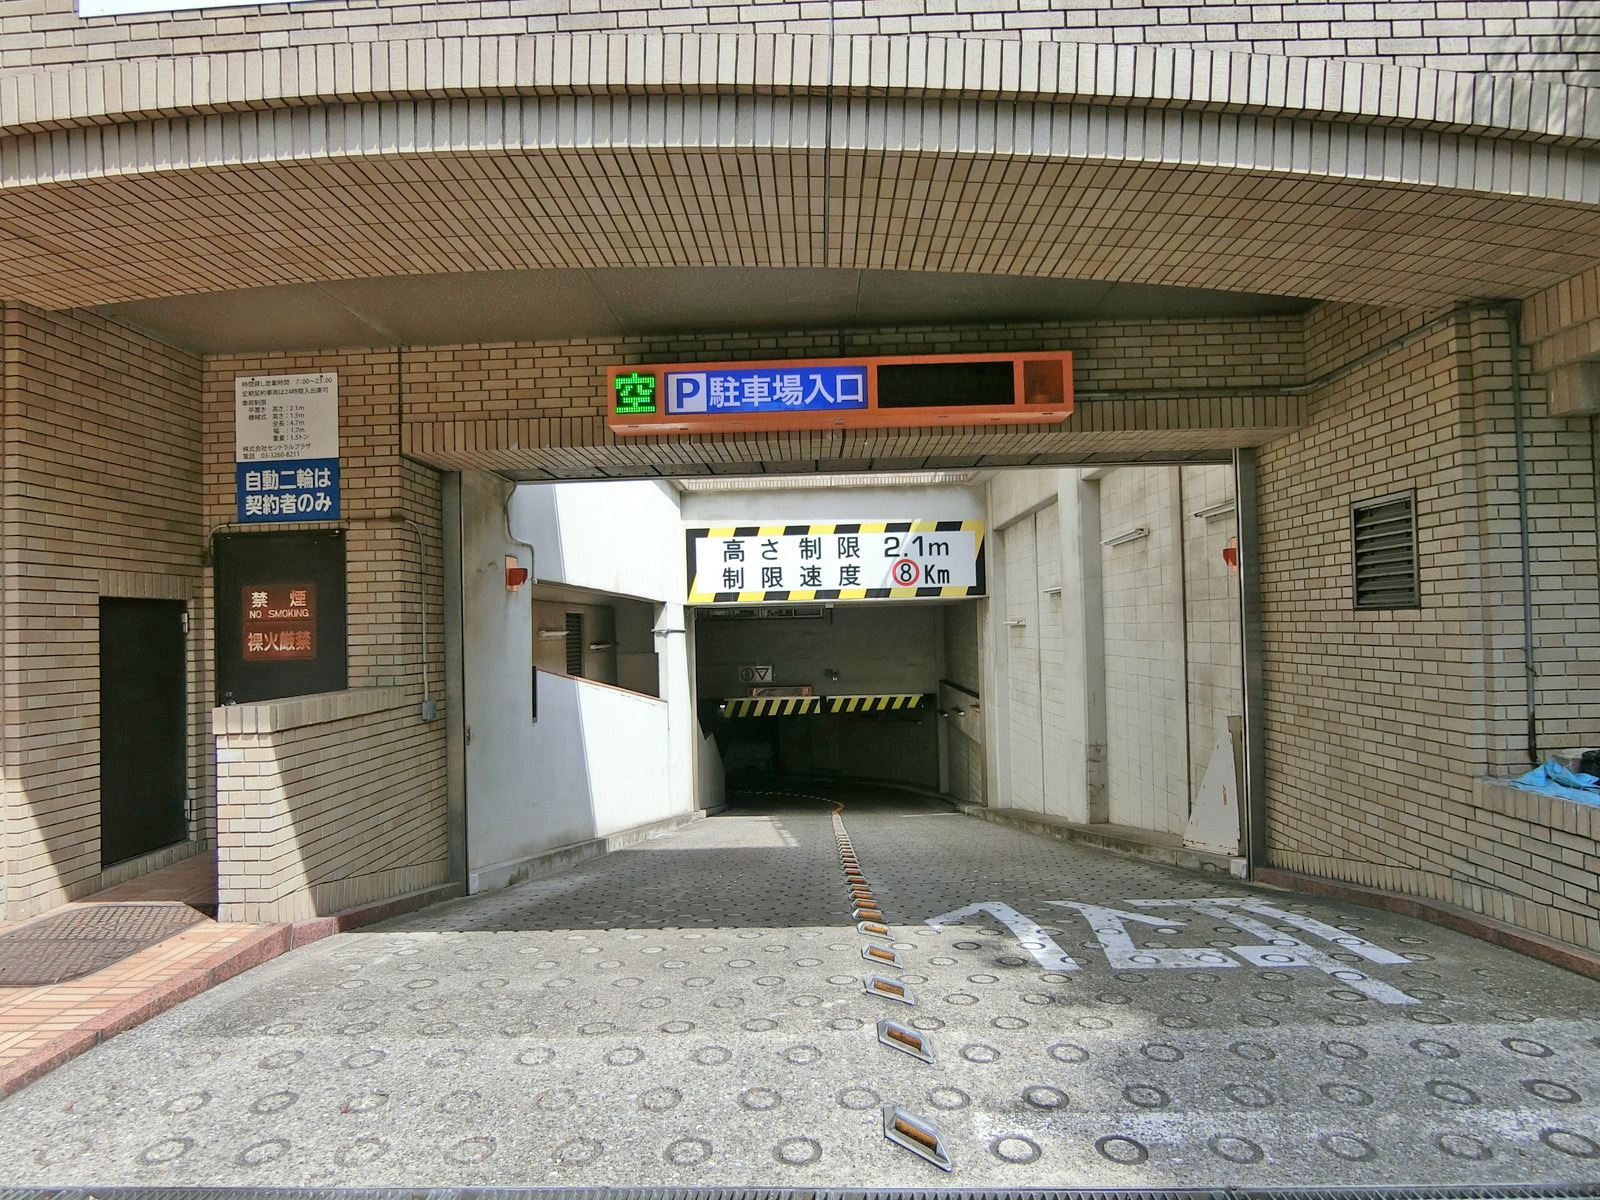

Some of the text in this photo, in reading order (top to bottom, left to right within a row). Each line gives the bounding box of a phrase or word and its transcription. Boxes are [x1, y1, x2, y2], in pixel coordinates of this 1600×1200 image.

[242, 379, 290, 388] 時間貸し営業時間
[242, 387, 329, 397] 定期契約車両は24時間入出庫可
[614, 372, 656, 414] 空
[709, 373, 864, 408] 駐車場入口
[242, 442, 311, 452] 株式会社セントラルプラザ
[245, 467, 332, 492] 自動二輪は
[245, 492, 333, 516] 契約者のみ
[884, 535, 950, 558] 2.1m
[924, 564, 951, 584] Km
[249, 608, 310, 619] NO SMOKING
[248, 631, 312, 652] 裸火厳禁
